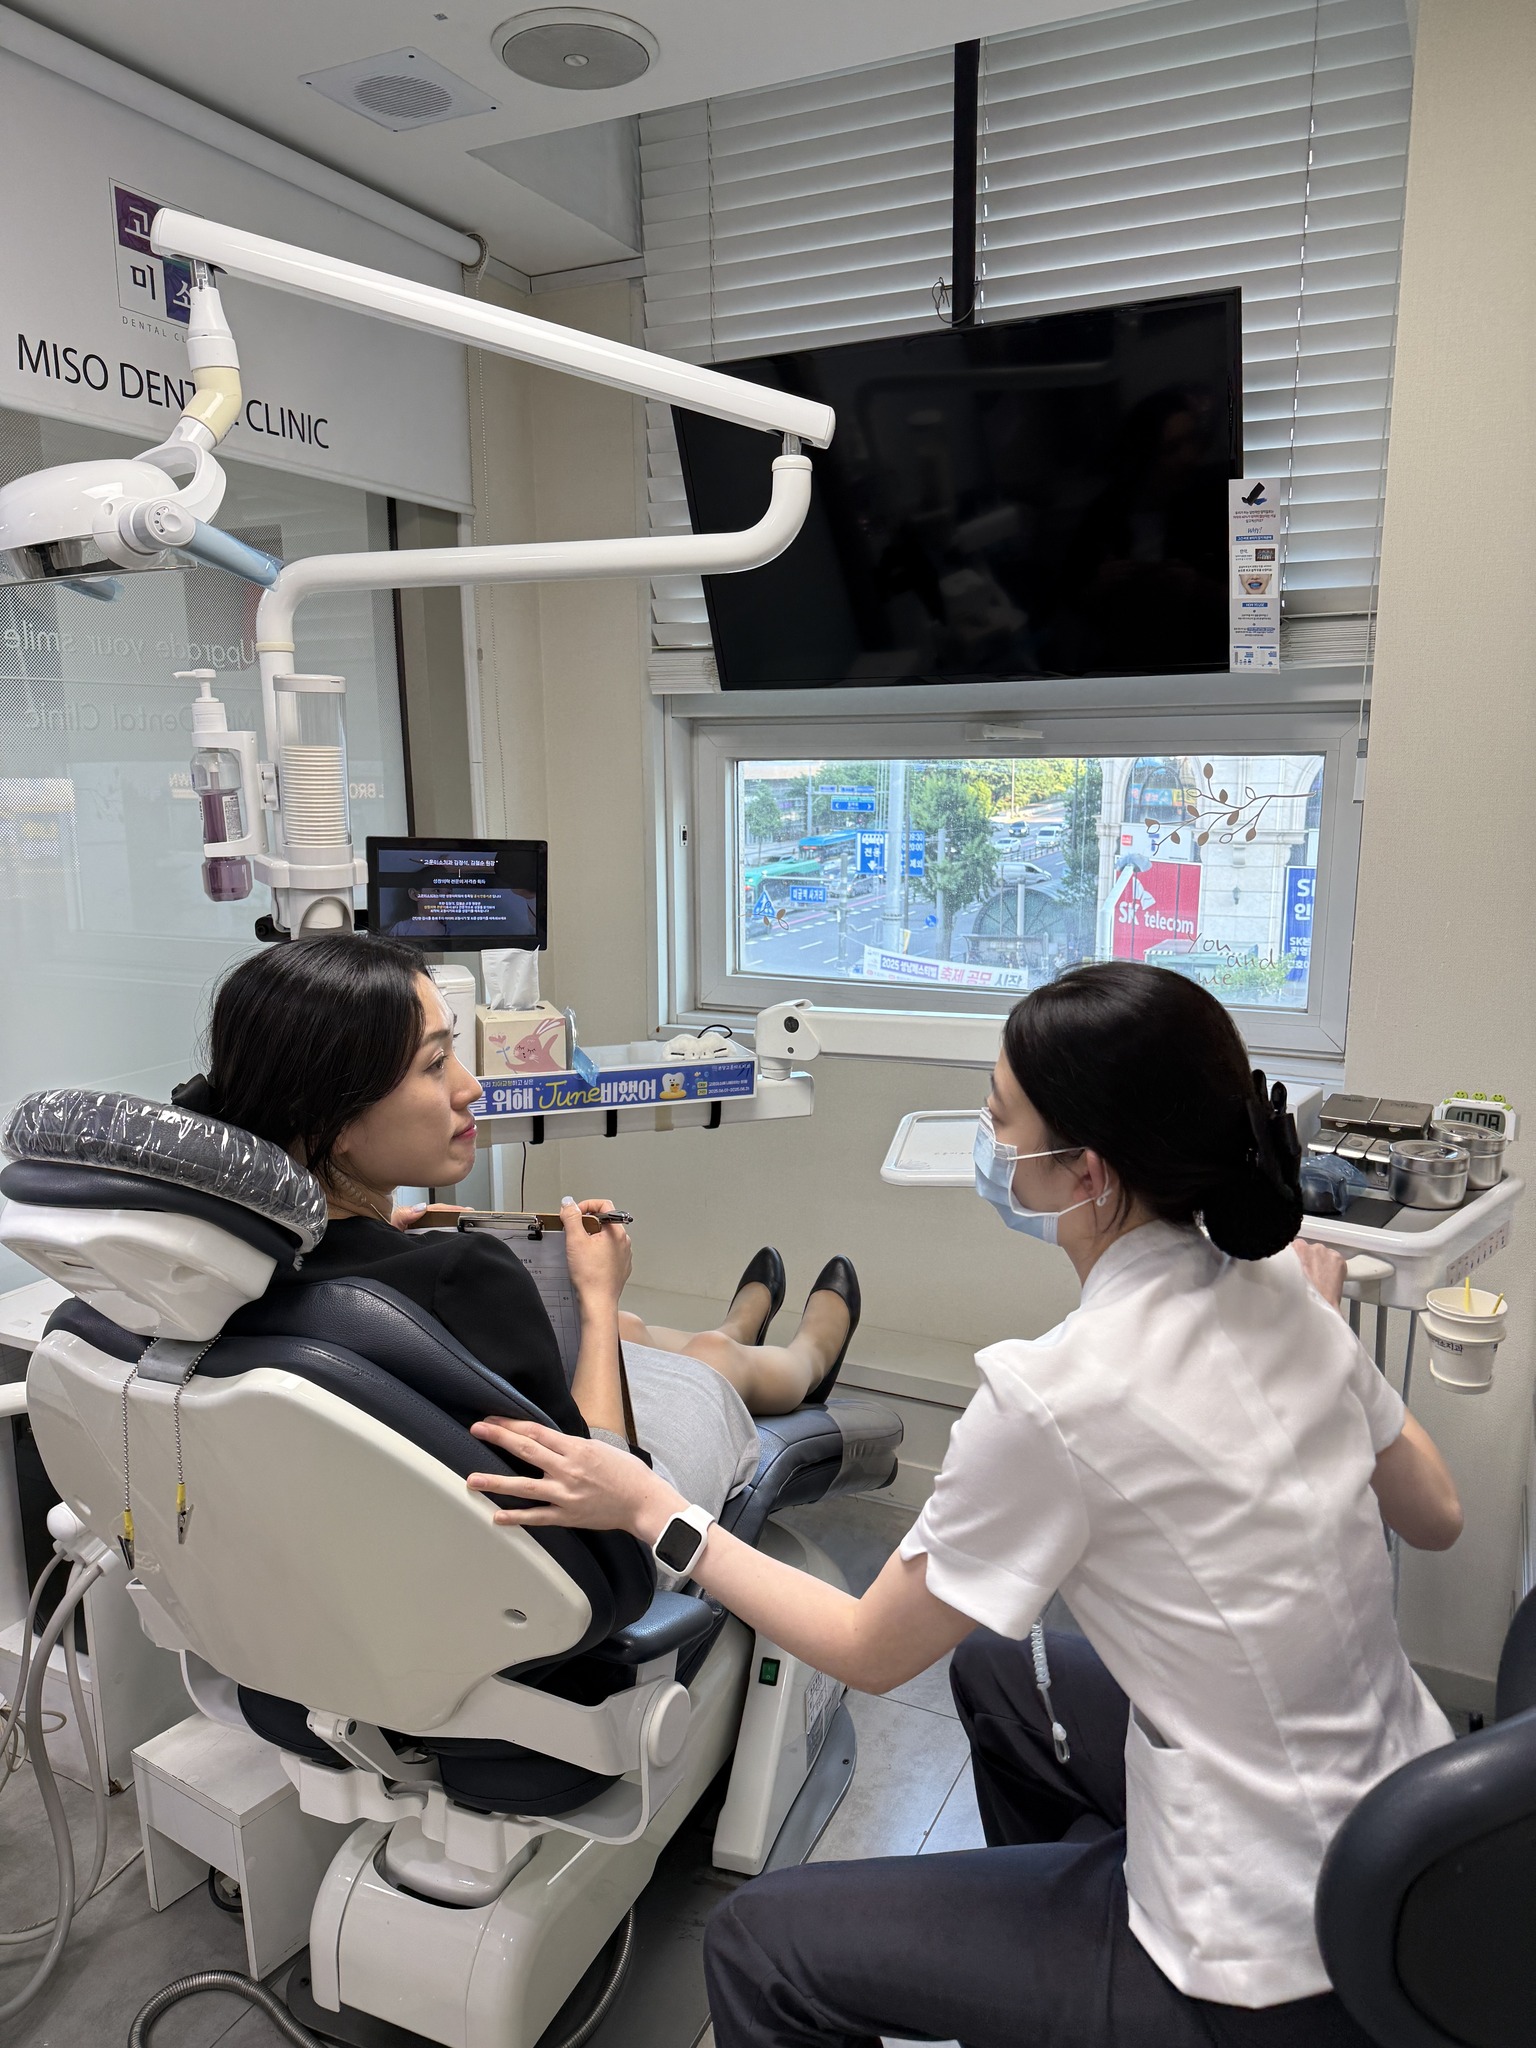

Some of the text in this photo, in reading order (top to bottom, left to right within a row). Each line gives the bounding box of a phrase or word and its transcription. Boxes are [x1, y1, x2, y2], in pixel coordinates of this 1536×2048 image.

[122, 316, 167, 339] DENTAL
[17, 333, 109, 392] MISO
[245, 399, 330, 450] CLINIC
[1118, 900, 1195, 935] SK telecom
[1187, 931, 1231, 954] You
[881, 957, 900, 971] 2025
[939, 966, 966, 983] 축제
[966, 969, 993, 986] 공모
[1226, 948, 1277, 971] and
[491, 1087, 534, 1112] 위해
